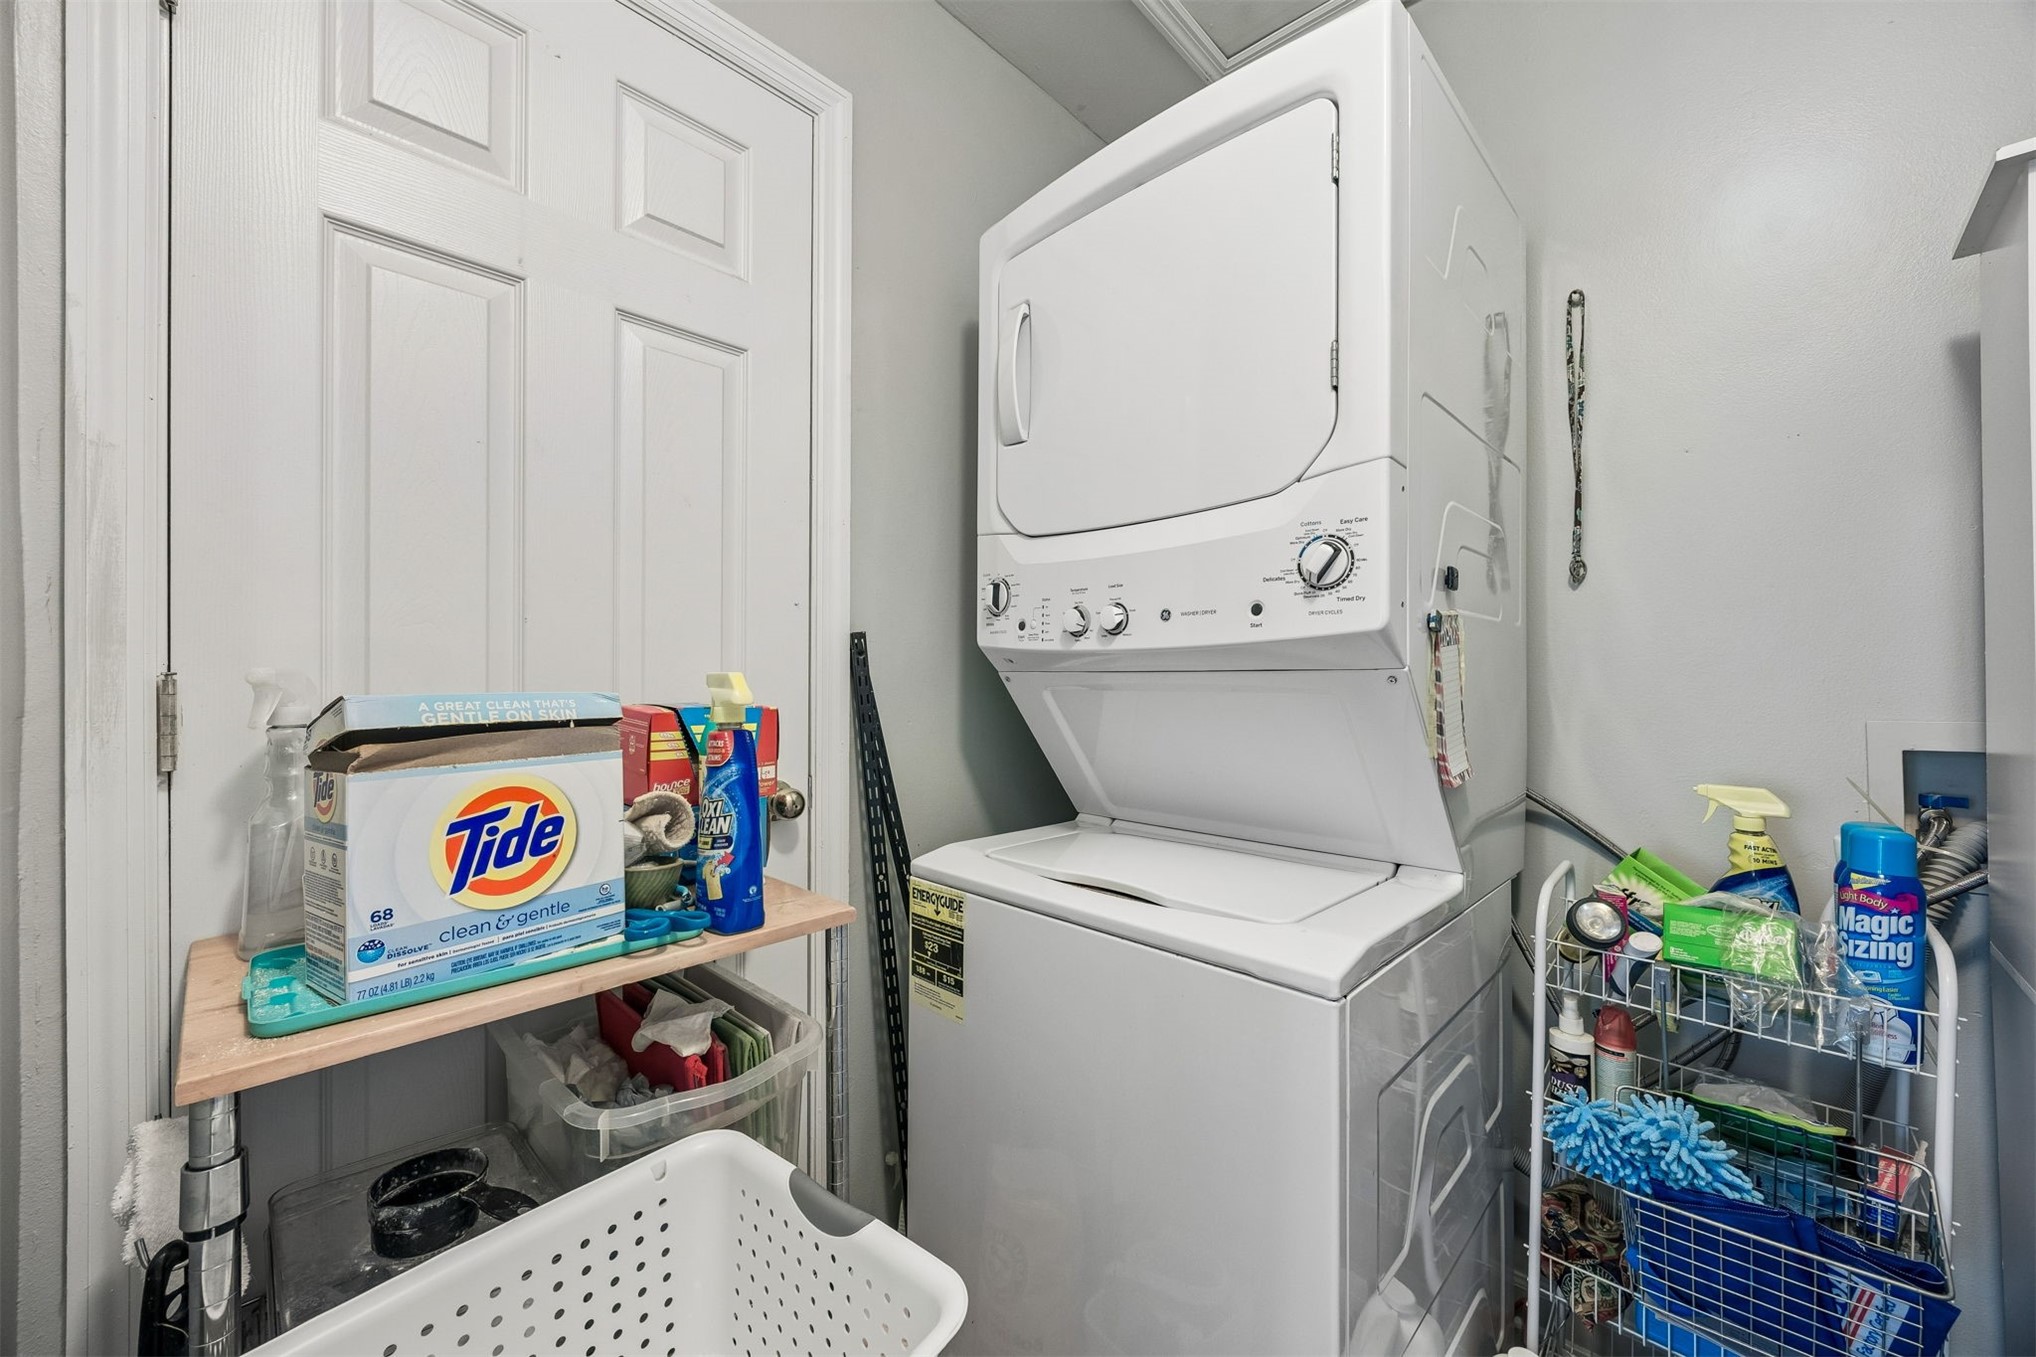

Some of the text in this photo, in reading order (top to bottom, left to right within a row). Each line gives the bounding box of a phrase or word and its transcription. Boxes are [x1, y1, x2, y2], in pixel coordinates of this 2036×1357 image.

[419, 699, 576, 712] A GREAT CLEAN THAT'S
[421, 709, 578, 724] GENTLE ON SKIN
[314, 772, 334, 808] Tide
[653, 779, 690, 791] bounce
[702, 798, 724, 817] OXI
[699, 813, 732, 835] LEAN
[446, 802, 564, 896] Tide
[912, 887, 964, 913] ENERGYGUIDE
[1860, 894, 1888, 910] Body
[370, 908, 393, 922] 68
[439, 921, 491, 942] clean
[496, 914, 514, 930] &
[517, 901, 570, 926] gentle
[1840, 906, 1913, 941] Magic
[925, 940, 938, 953] $23
[1838, 931, 1913, 968] Sizing
[408, 955, 435, 965] sensitive
[357, 972, 435, 1000] 77 OZ (4.81 LB) 2.2 kg
[1551, 1076, 1580, 1097] DUST
